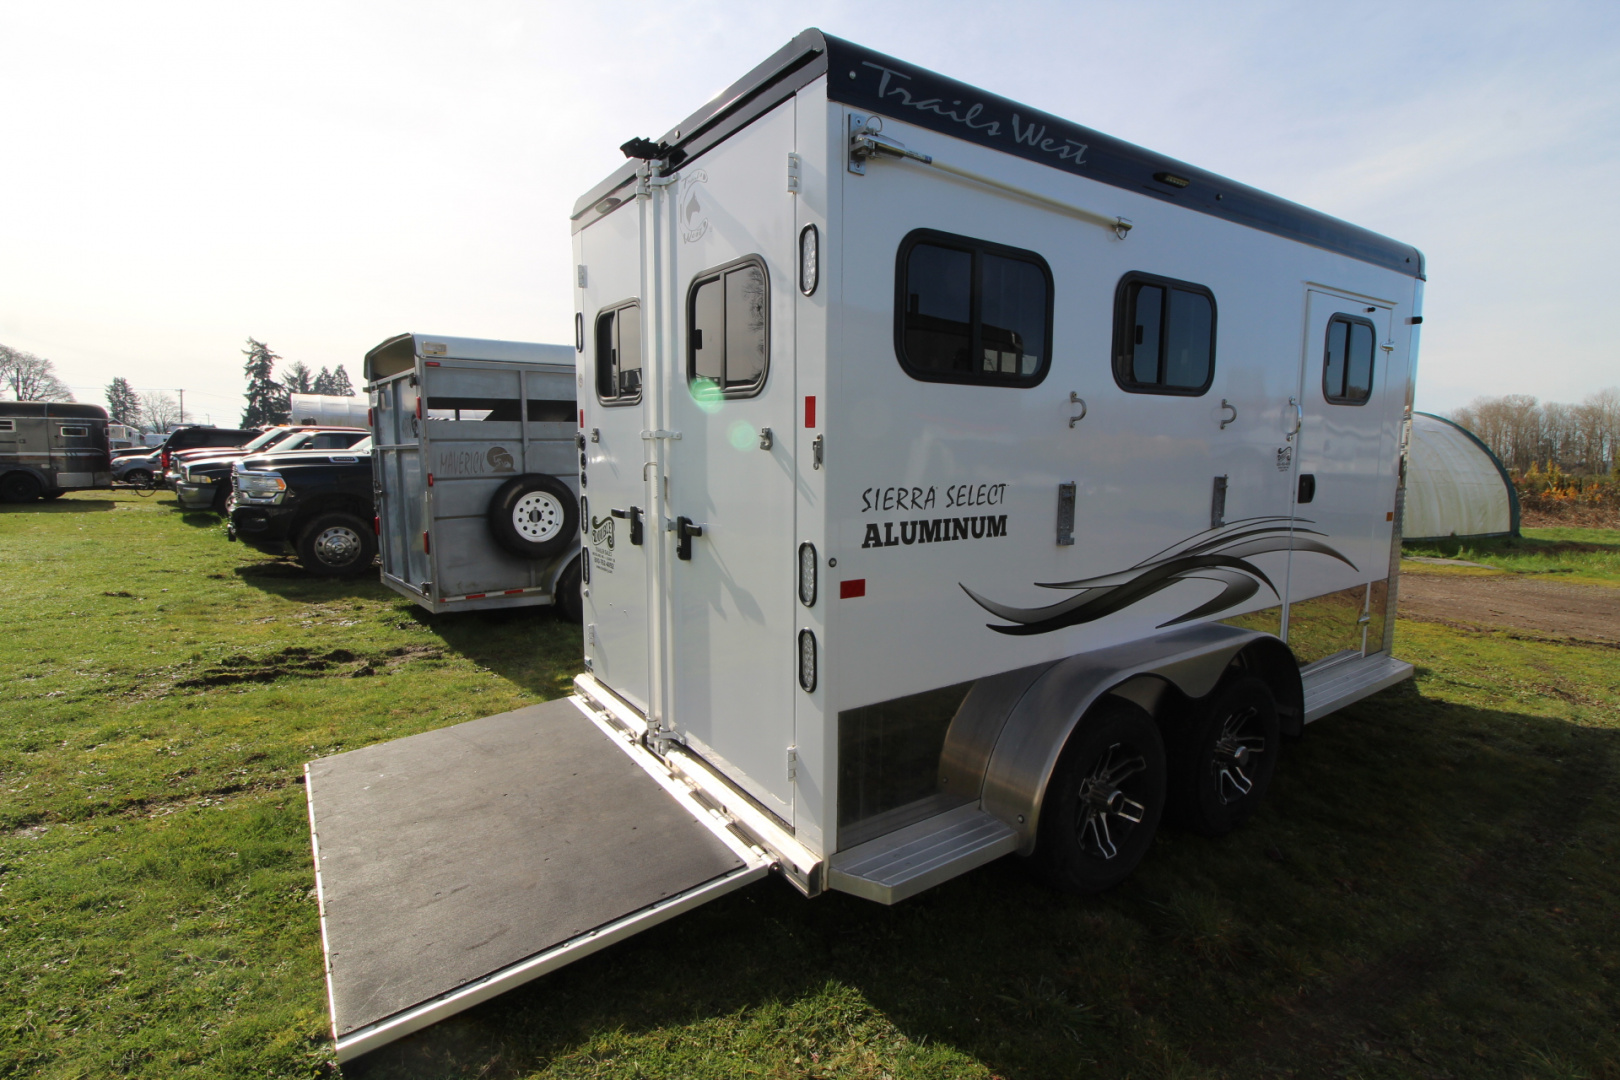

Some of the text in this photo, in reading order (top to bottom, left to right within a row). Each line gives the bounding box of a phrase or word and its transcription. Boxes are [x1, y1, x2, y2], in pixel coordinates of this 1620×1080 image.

[862, 61, 1088, 165] Trails West
[440, 450, 486, 475] MAVERICK
[861, 483, 1007, 513] SIERRA SELECT
[861, 514, 1008, 549] ALUMINUM
